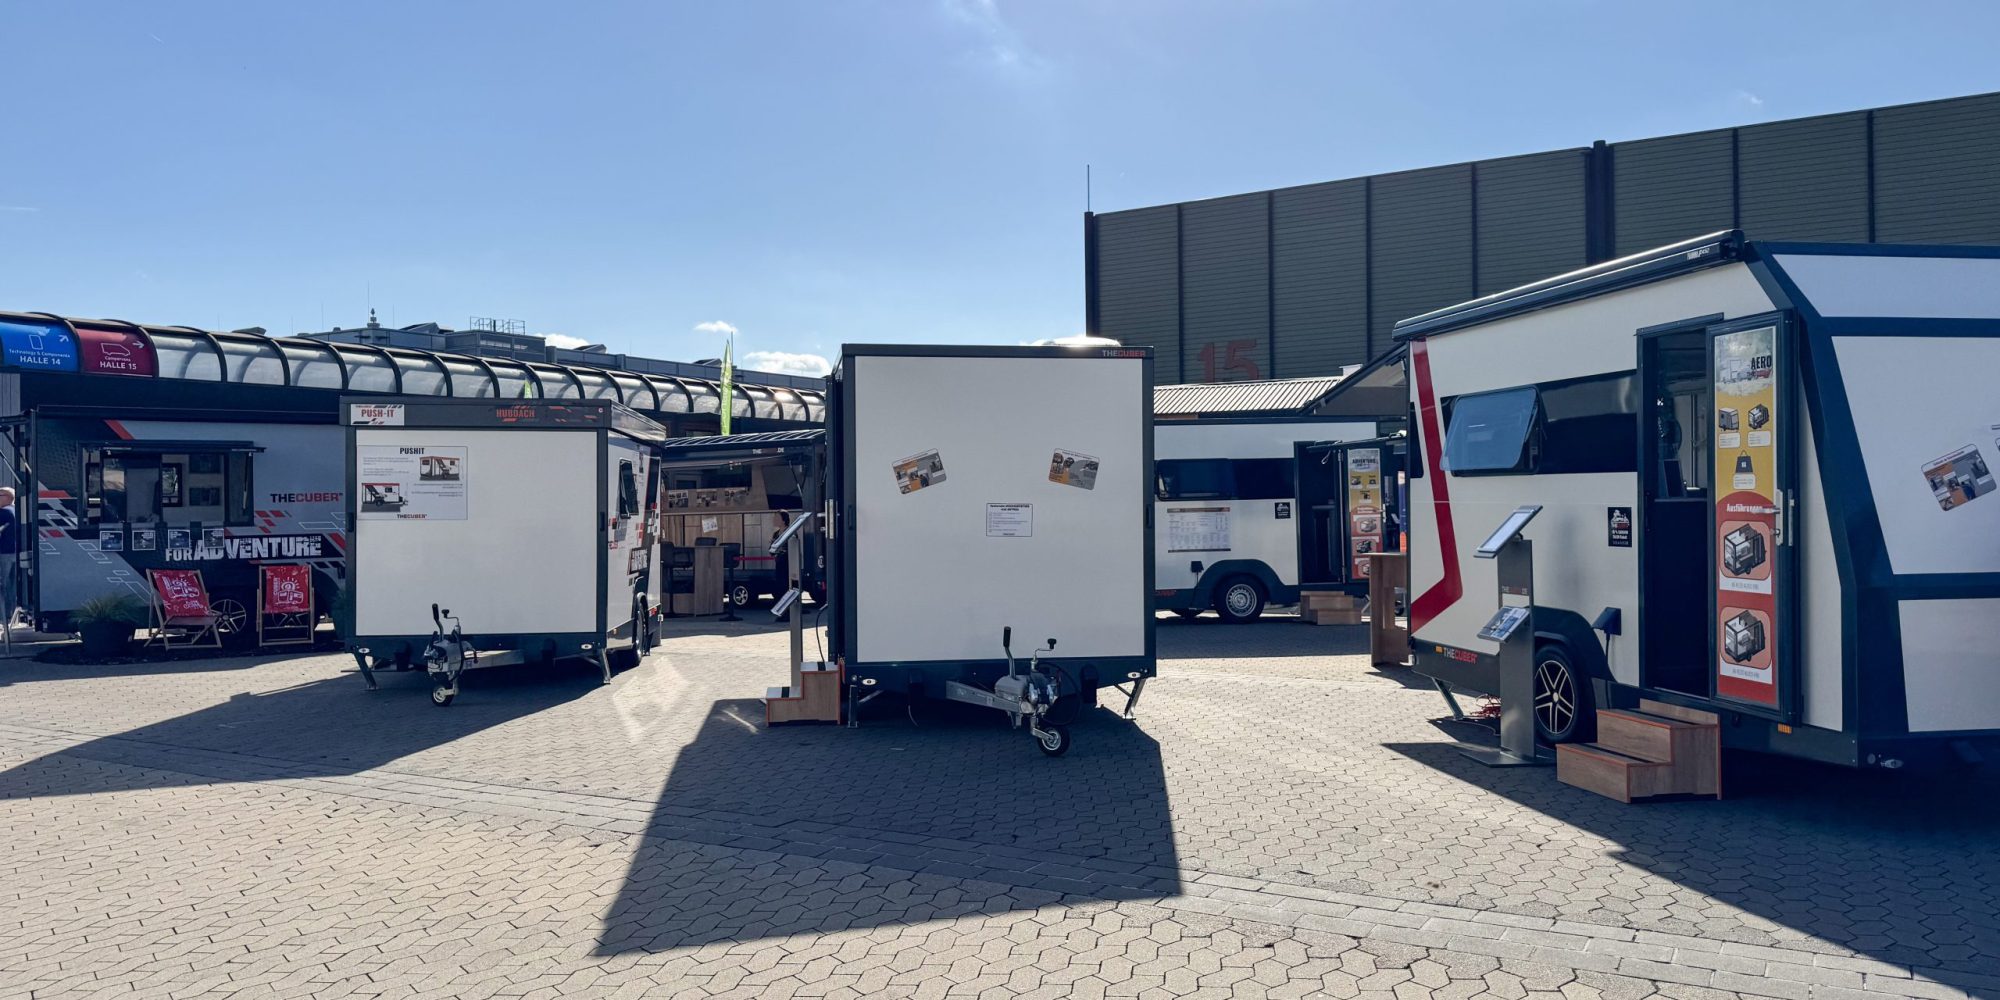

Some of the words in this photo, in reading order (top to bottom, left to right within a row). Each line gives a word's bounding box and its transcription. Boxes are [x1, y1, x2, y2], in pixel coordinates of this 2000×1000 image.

[20, 355, 49, 364] HALLE
[51, 357, 61, 365] 14
[99, 361, 126, 369] HALLE
[1198, 339, 1260, 383] 15
[1750, 355, 1773, 370] AERO
[361, 409, 395, 418] PUSH-IT
[399, 447, 425, 455] PUSHIT
[165, 548, 193, 561] FOR
[193, 535, 322, 560] ADVENTURE
